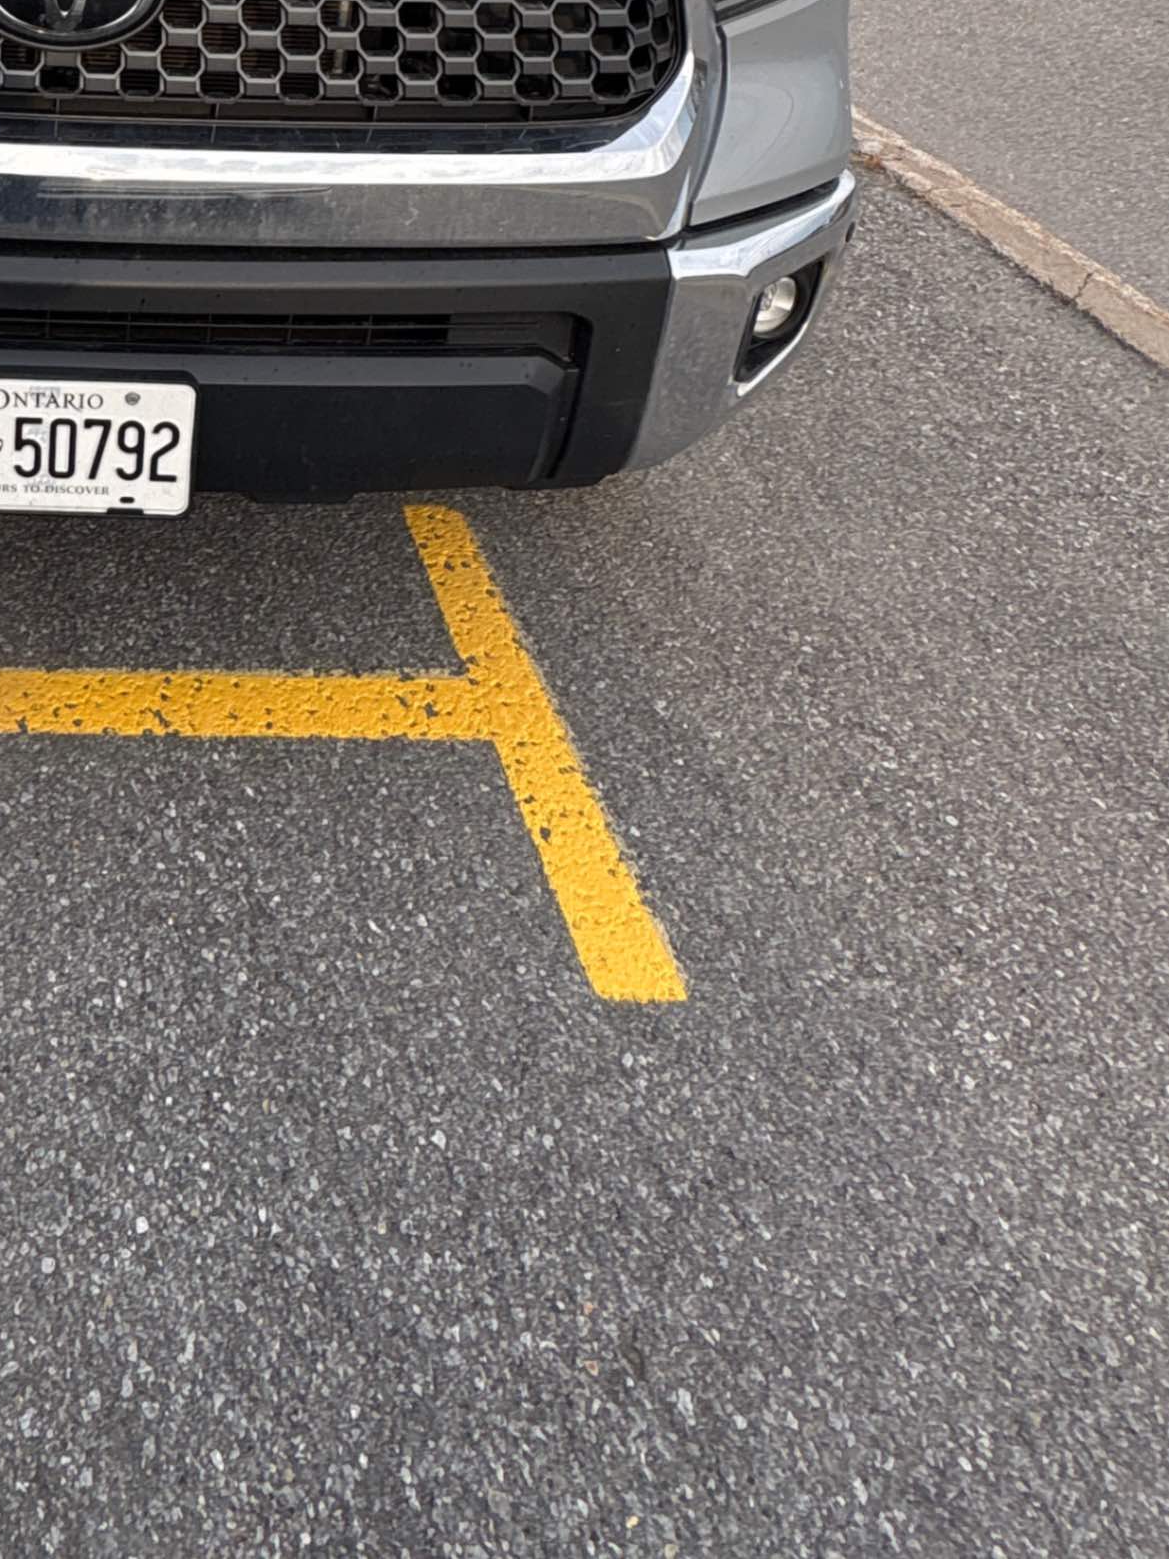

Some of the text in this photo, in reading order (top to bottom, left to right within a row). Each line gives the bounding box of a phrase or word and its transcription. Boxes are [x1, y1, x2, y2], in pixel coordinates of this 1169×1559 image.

[13, 417, 180, 482] 50792
[23, 484, 41, 494] TO
[44, 485, 110, 496] DISCOVER
